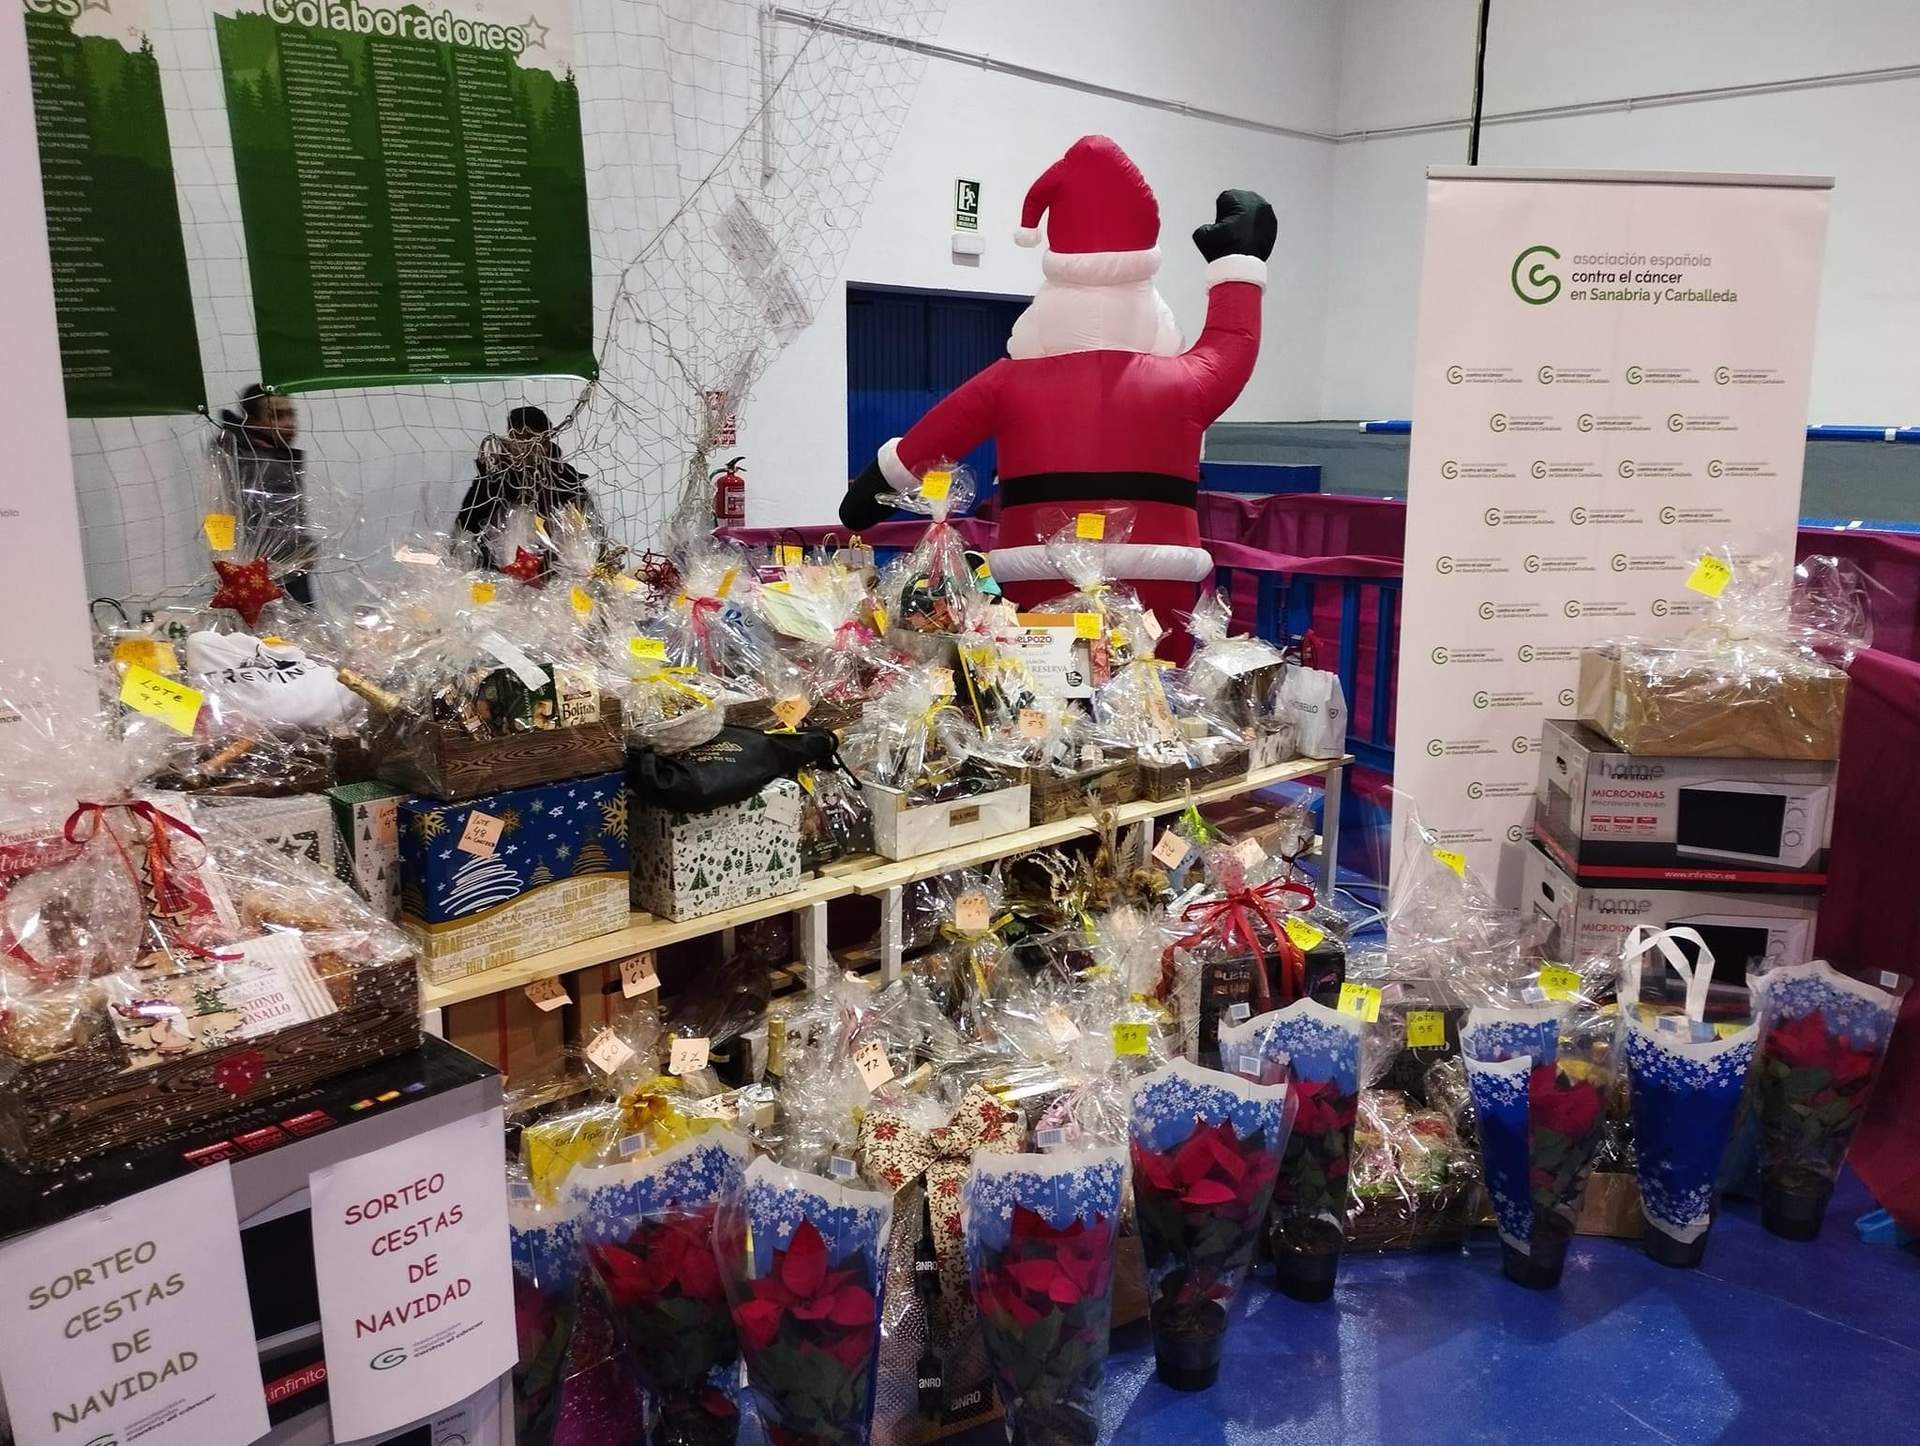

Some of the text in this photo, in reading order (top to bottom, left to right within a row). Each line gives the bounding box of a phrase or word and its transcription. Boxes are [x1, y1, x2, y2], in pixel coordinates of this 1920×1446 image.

[266, 0, 525, 52] Colaboradores
[1571, 270, 1683, 284] contra el cáncer
[1573, 252, 1711, 269] asociación española
[1570, 287, 1738, 305] en Sanabria y Carballeda
[1600, 760, 1665, 778] home
[1591, 789, 1665, 799] MICROONDAS
[1589, 895, 1652, 912] home
[1582, 923, 1633, 933] MICROON
[344, 1173, 446, 1227] SORTEO
[370, 1204, 465, 1258] CESTAS
[26, 1240, 158, 1312] SORTEO
[407, 1253, 439, 1285] DE
[63, 1273, 186, 1340] CESTAS
[354, 1278, 473, 1339] NAVIDAD
[112, 1328, 153, 1364] DE
[51, 1350, 200, 1434] NAVIDAD
[266, 1367, 327, 1402] .infinito
